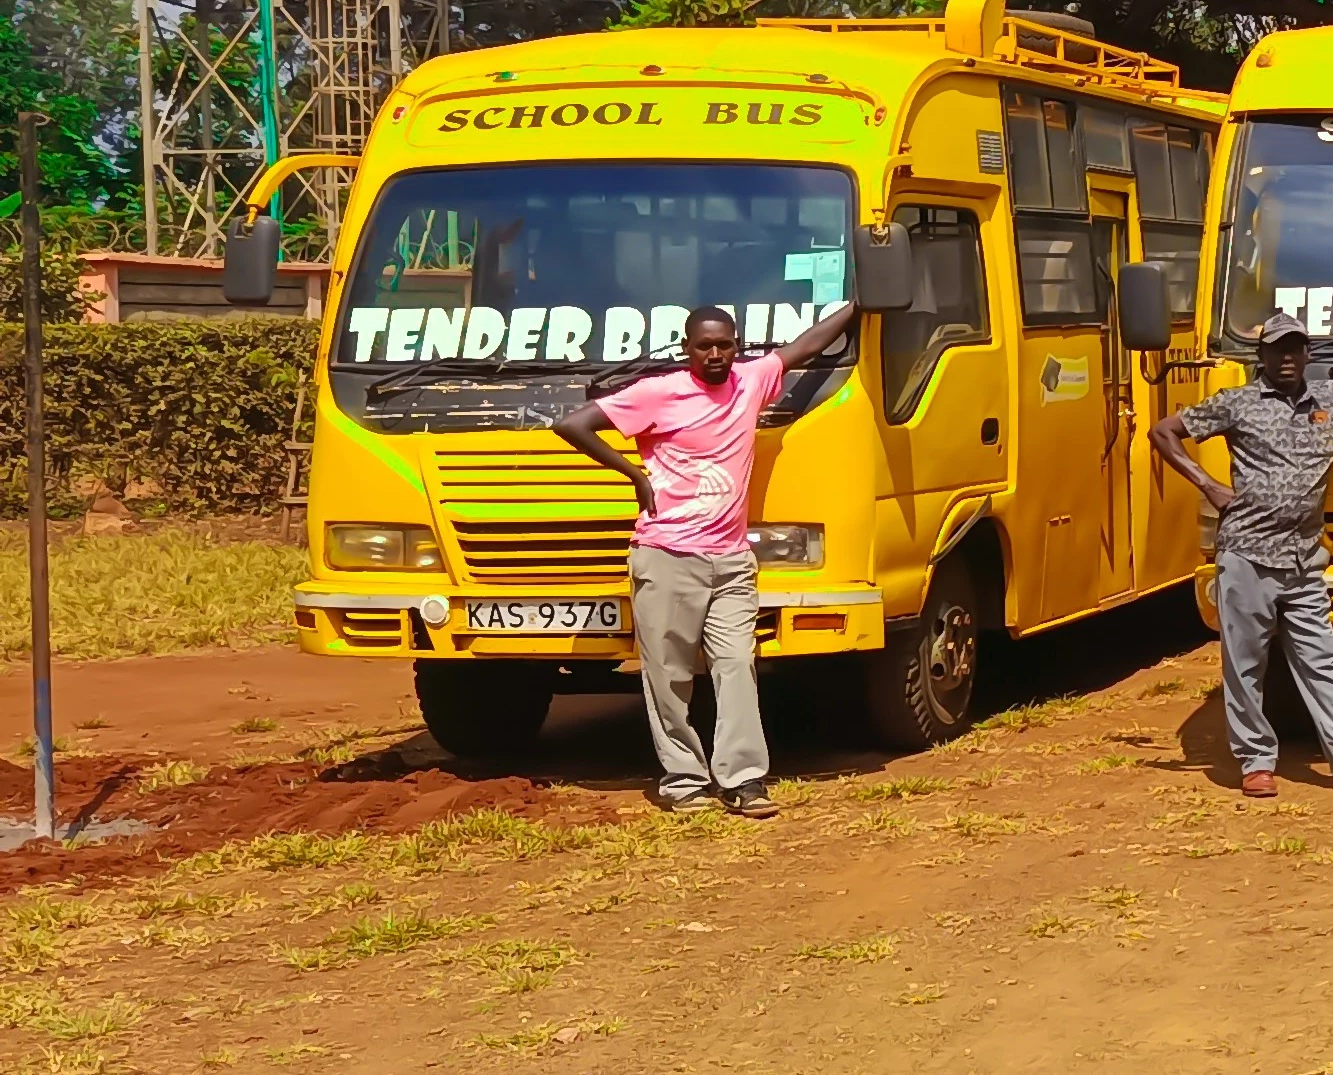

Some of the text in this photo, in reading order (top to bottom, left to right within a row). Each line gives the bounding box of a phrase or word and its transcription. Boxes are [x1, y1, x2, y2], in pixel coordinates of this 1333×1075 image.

[438, 102, 824, 132] SCHOOL BUS
[350, 301, 850, 362] TENDER BRINS
[467, 601, 617, 628] KAS 937G
